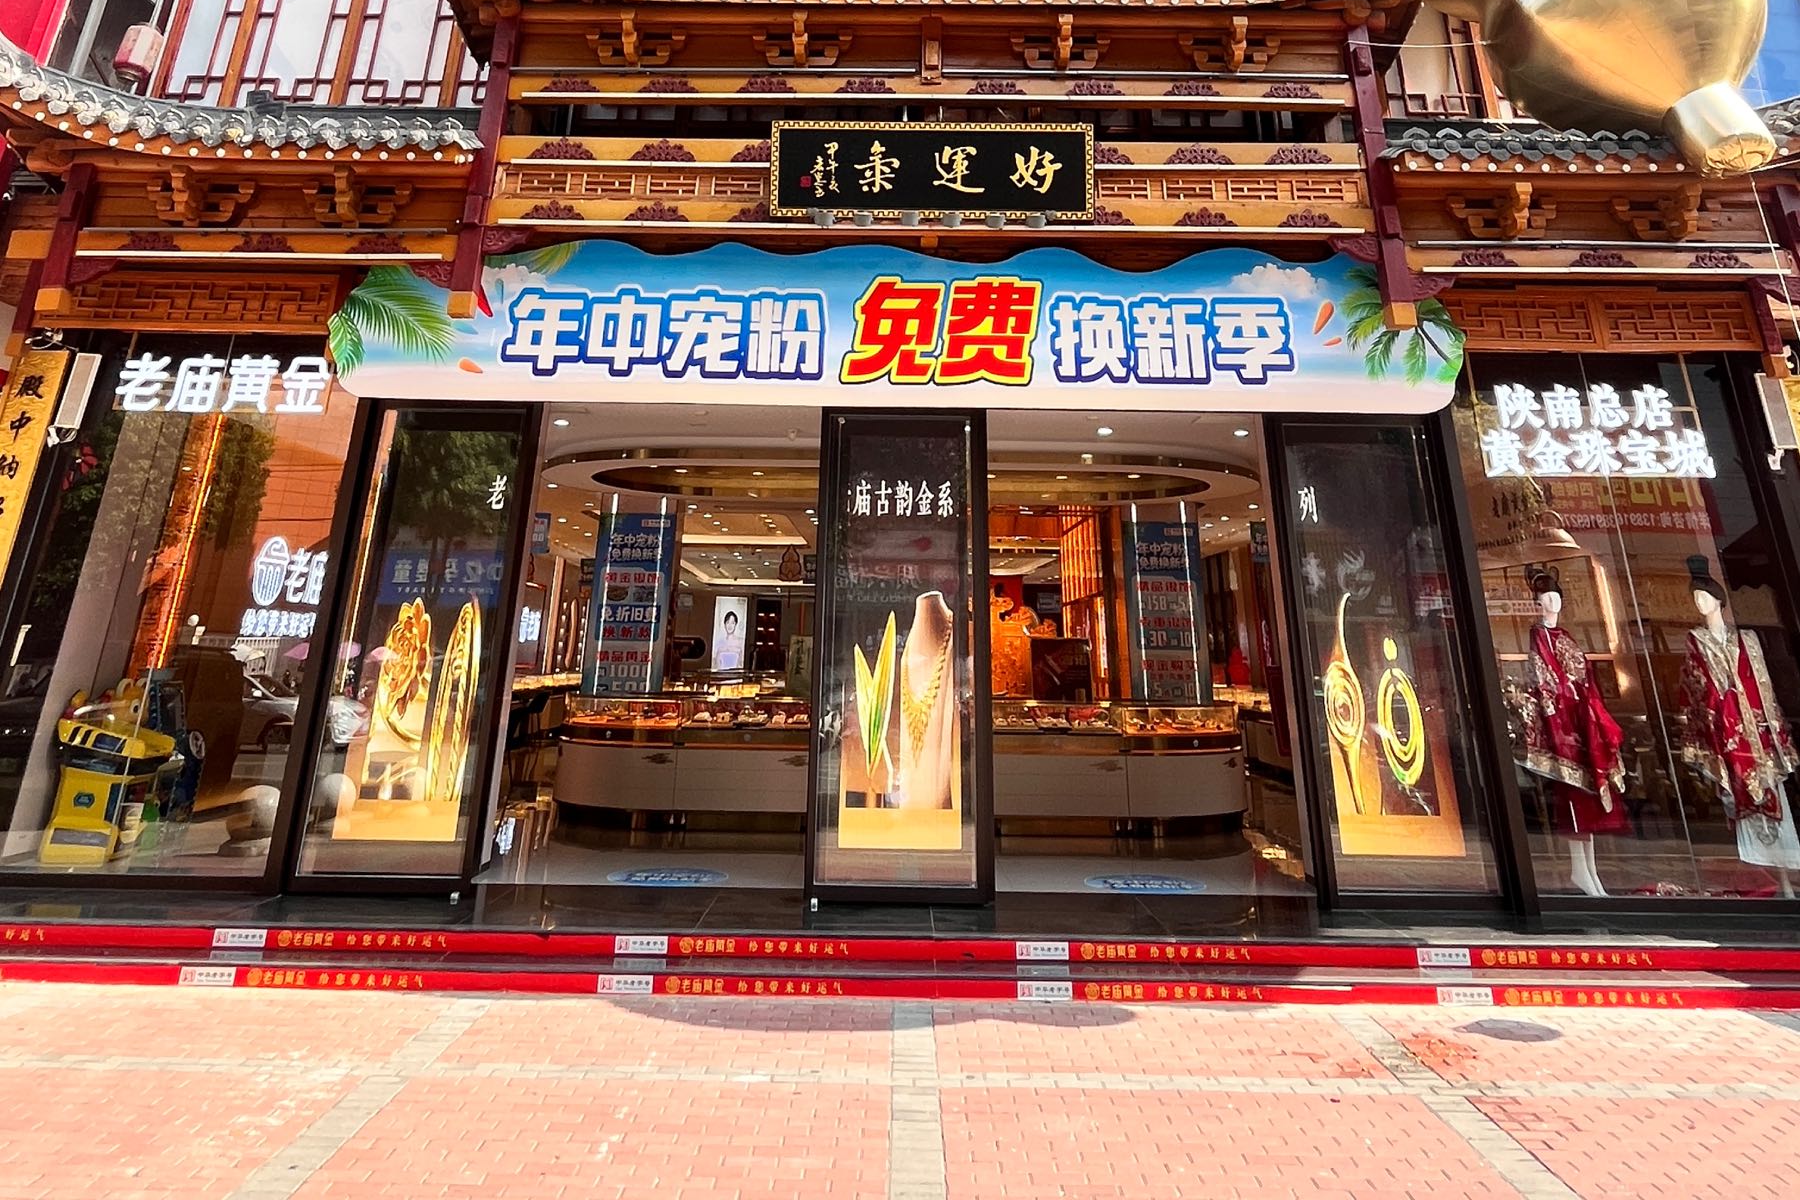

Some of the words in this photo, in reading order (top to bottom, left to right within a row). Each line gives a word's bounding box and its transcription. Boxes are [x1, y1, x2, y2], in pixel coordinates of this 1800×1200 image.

[115, 352, 331, 413] 老庙黄金
[1493, 383, 1674, 430] 陕南总店
[1483, 428, 1717, 478] 黄金珠宝城
[486, 474, 508, 510] 老
[852, 479, 953, 518] 庙古韵金系
[1297, 485, 1318, 524] 列
[284, 547, 328, 606] 老庙
